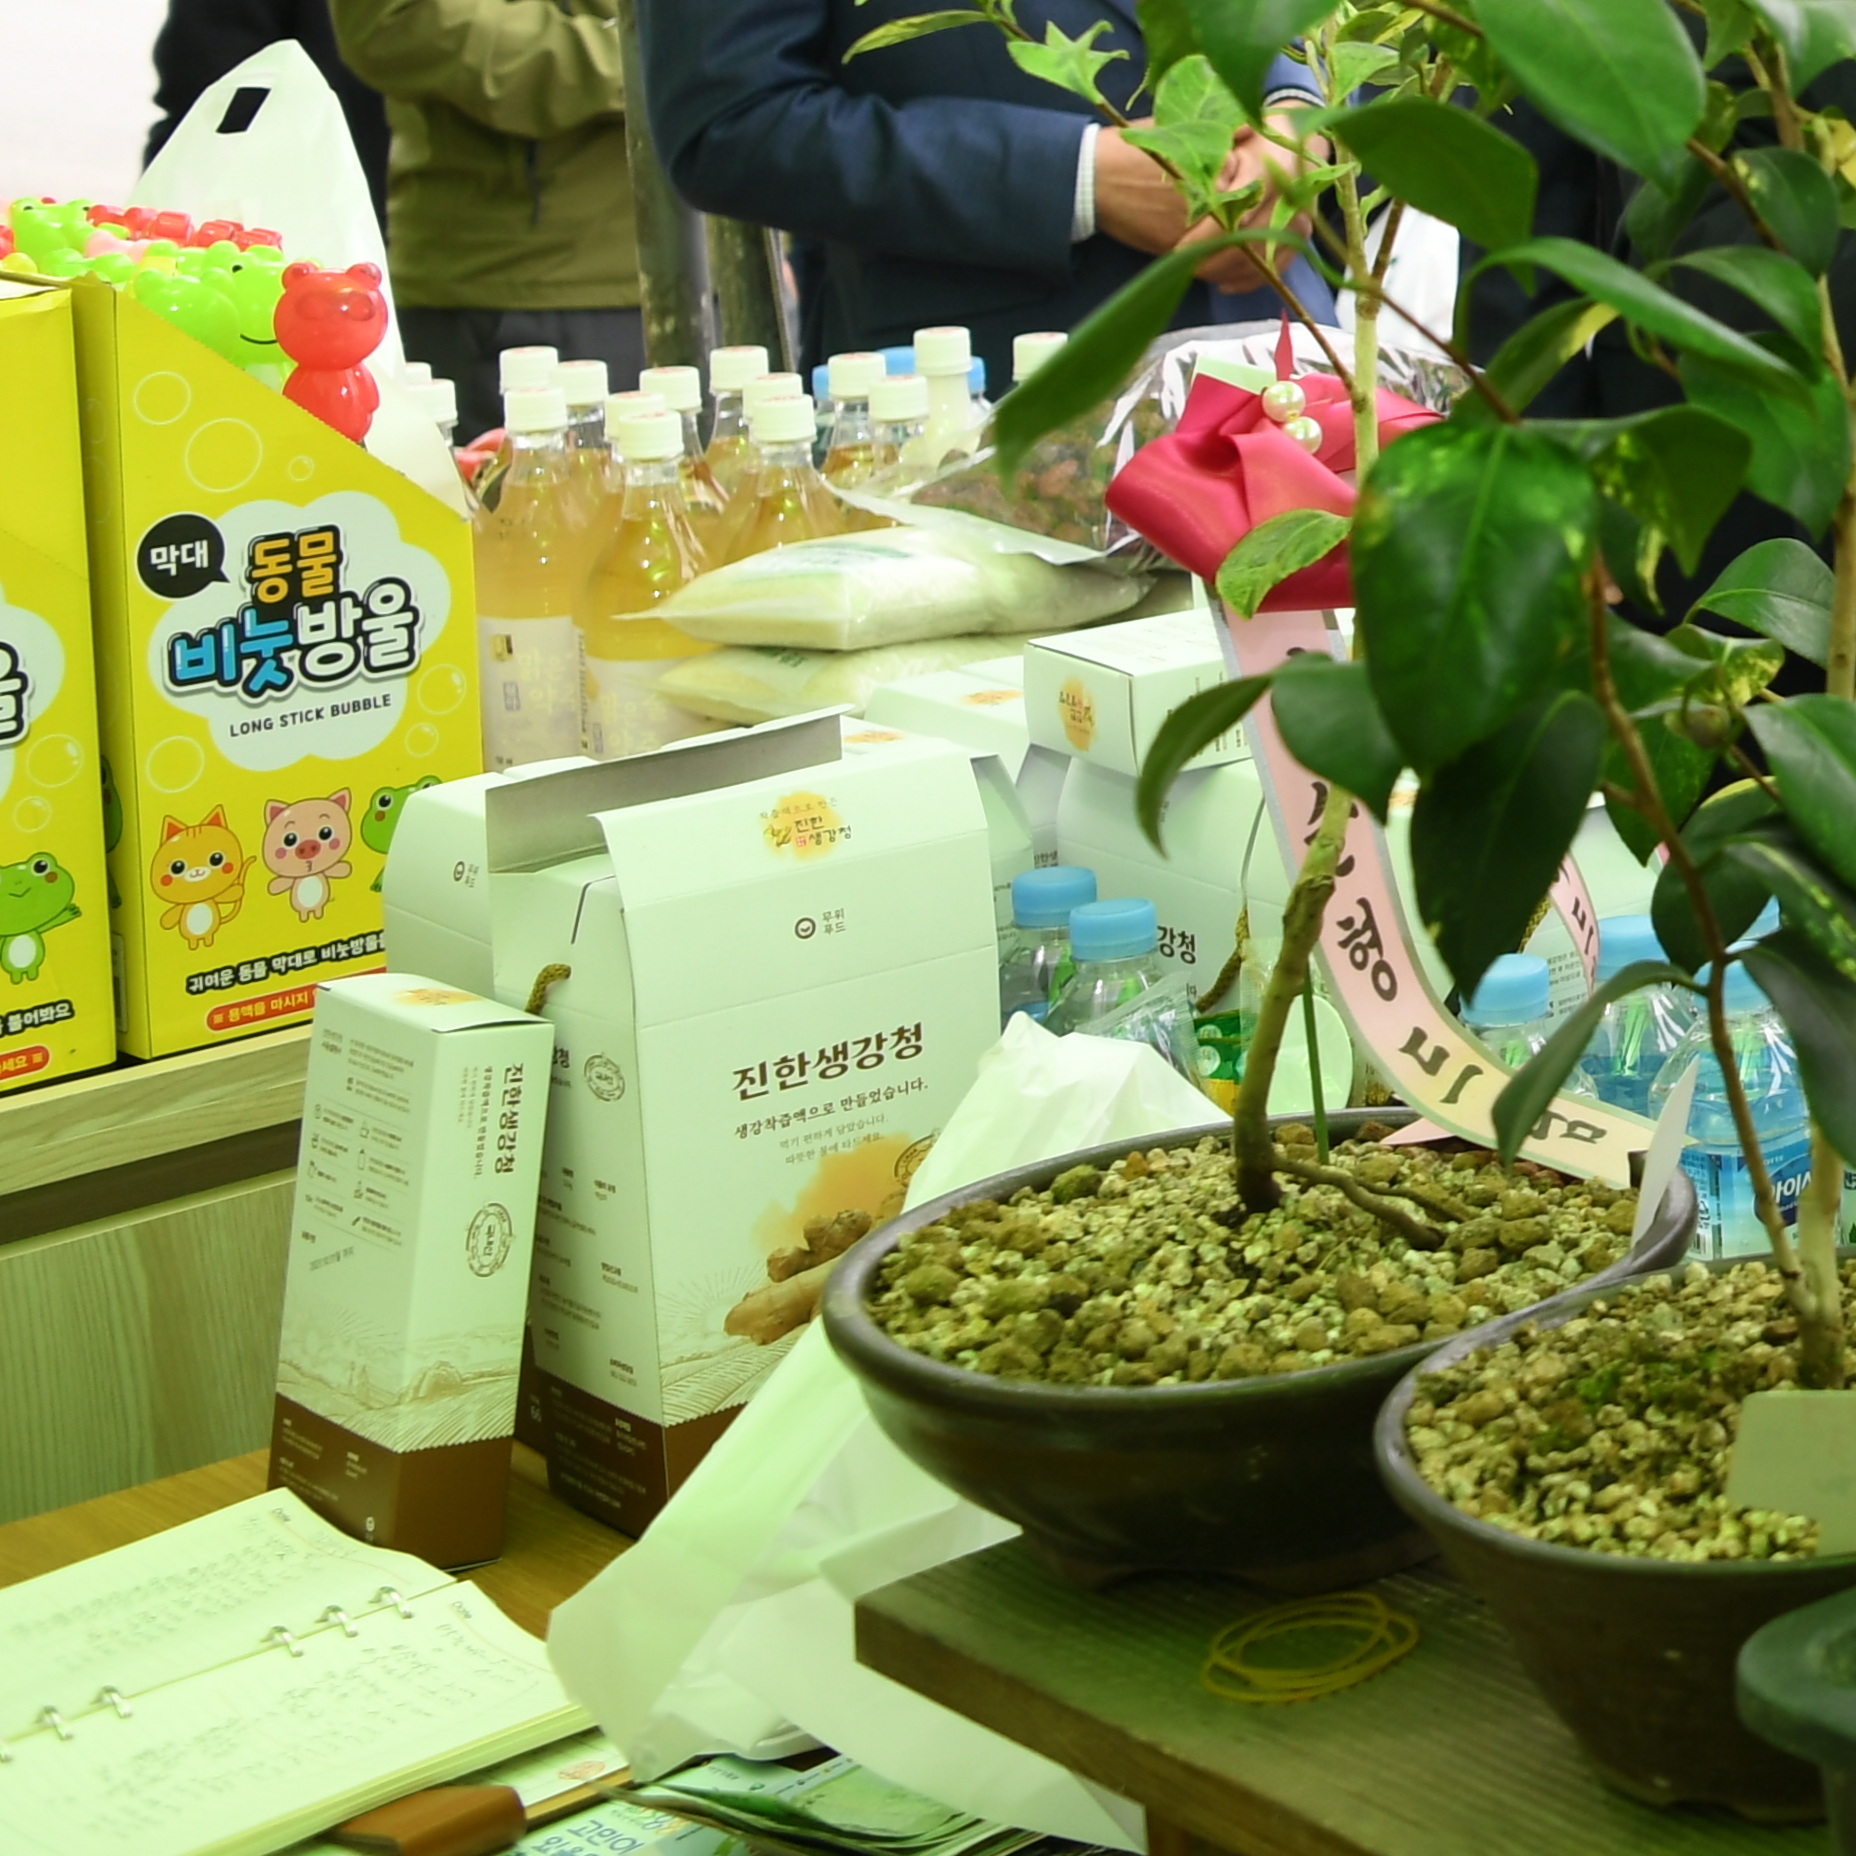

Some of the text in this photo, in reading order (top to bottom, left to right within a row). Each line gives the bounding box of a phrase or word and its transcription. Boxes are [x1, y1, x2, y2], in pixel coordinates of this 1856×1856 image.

[149, 539, 210, 577] 막대
[250, 528, 340, 605] 동물
[171, 581, 416, 695] 비눗방울
[229, 693, 392, 738] LONG STICK BUBBLE
[188, 969, 236, 992] 귀여운
[271, 949, 318, 973] 막대로
[270, 991, 309, 1011] 마시지
[1, 1054, 28, 1074] 세요
[731, 1021, 923, 1102] 진한생강청
[494, 1062, 524, 1175] 진한생강청
[733, 1076, 930, 1140] 생강착즙액으로 만들었습니다.
[1763, 1154, 1785, 1165] OTTE
